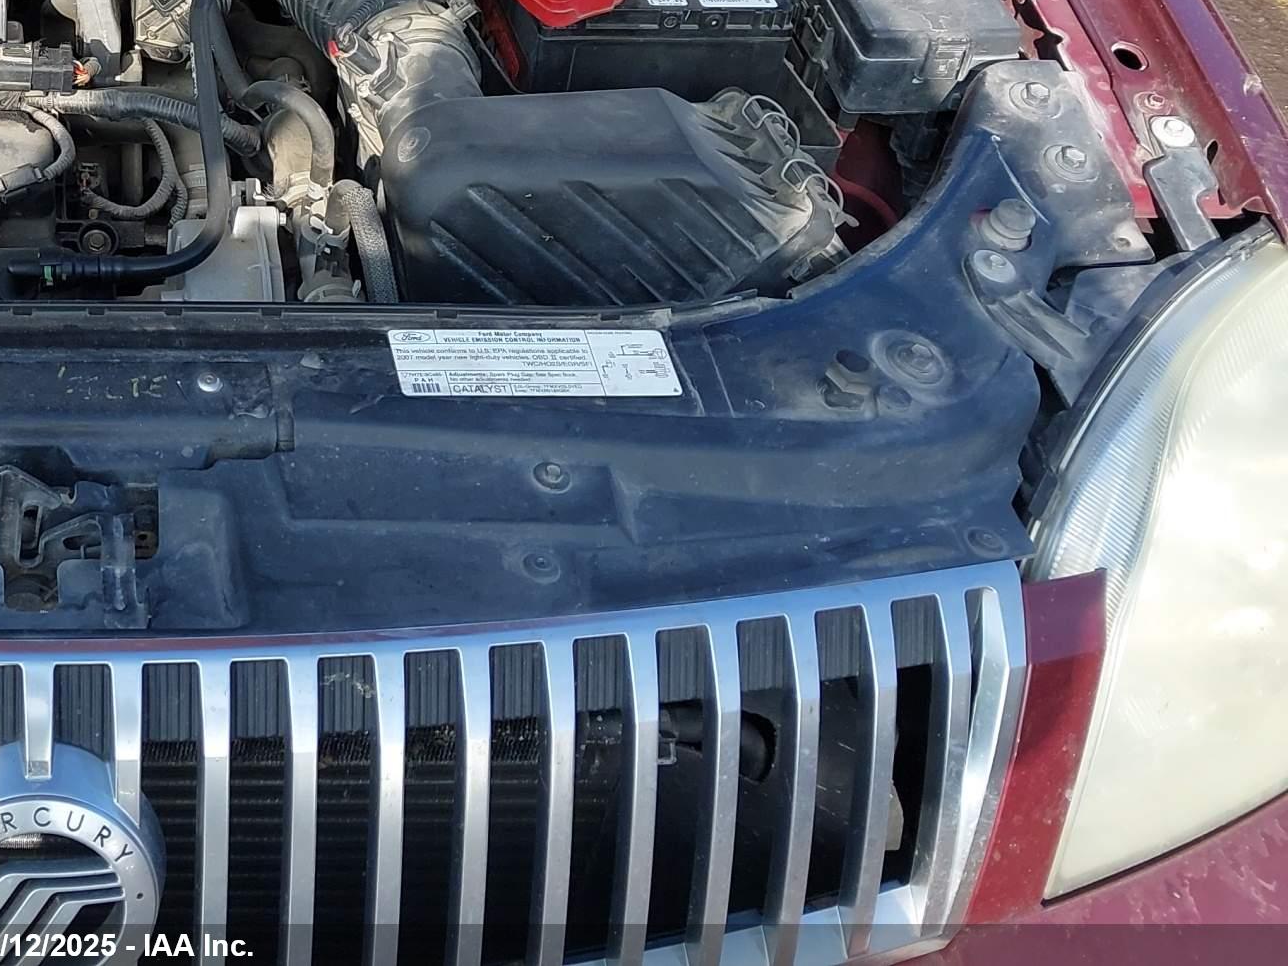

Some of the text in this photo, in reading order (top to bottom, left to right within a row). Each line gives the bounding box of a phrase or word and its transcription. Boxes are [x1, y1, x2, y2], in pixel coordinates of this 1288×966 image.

[401, 332, 423, 341] Ford
[514, 330, 543, 338] Company
[453, 384, 507, 394] CATALYST
